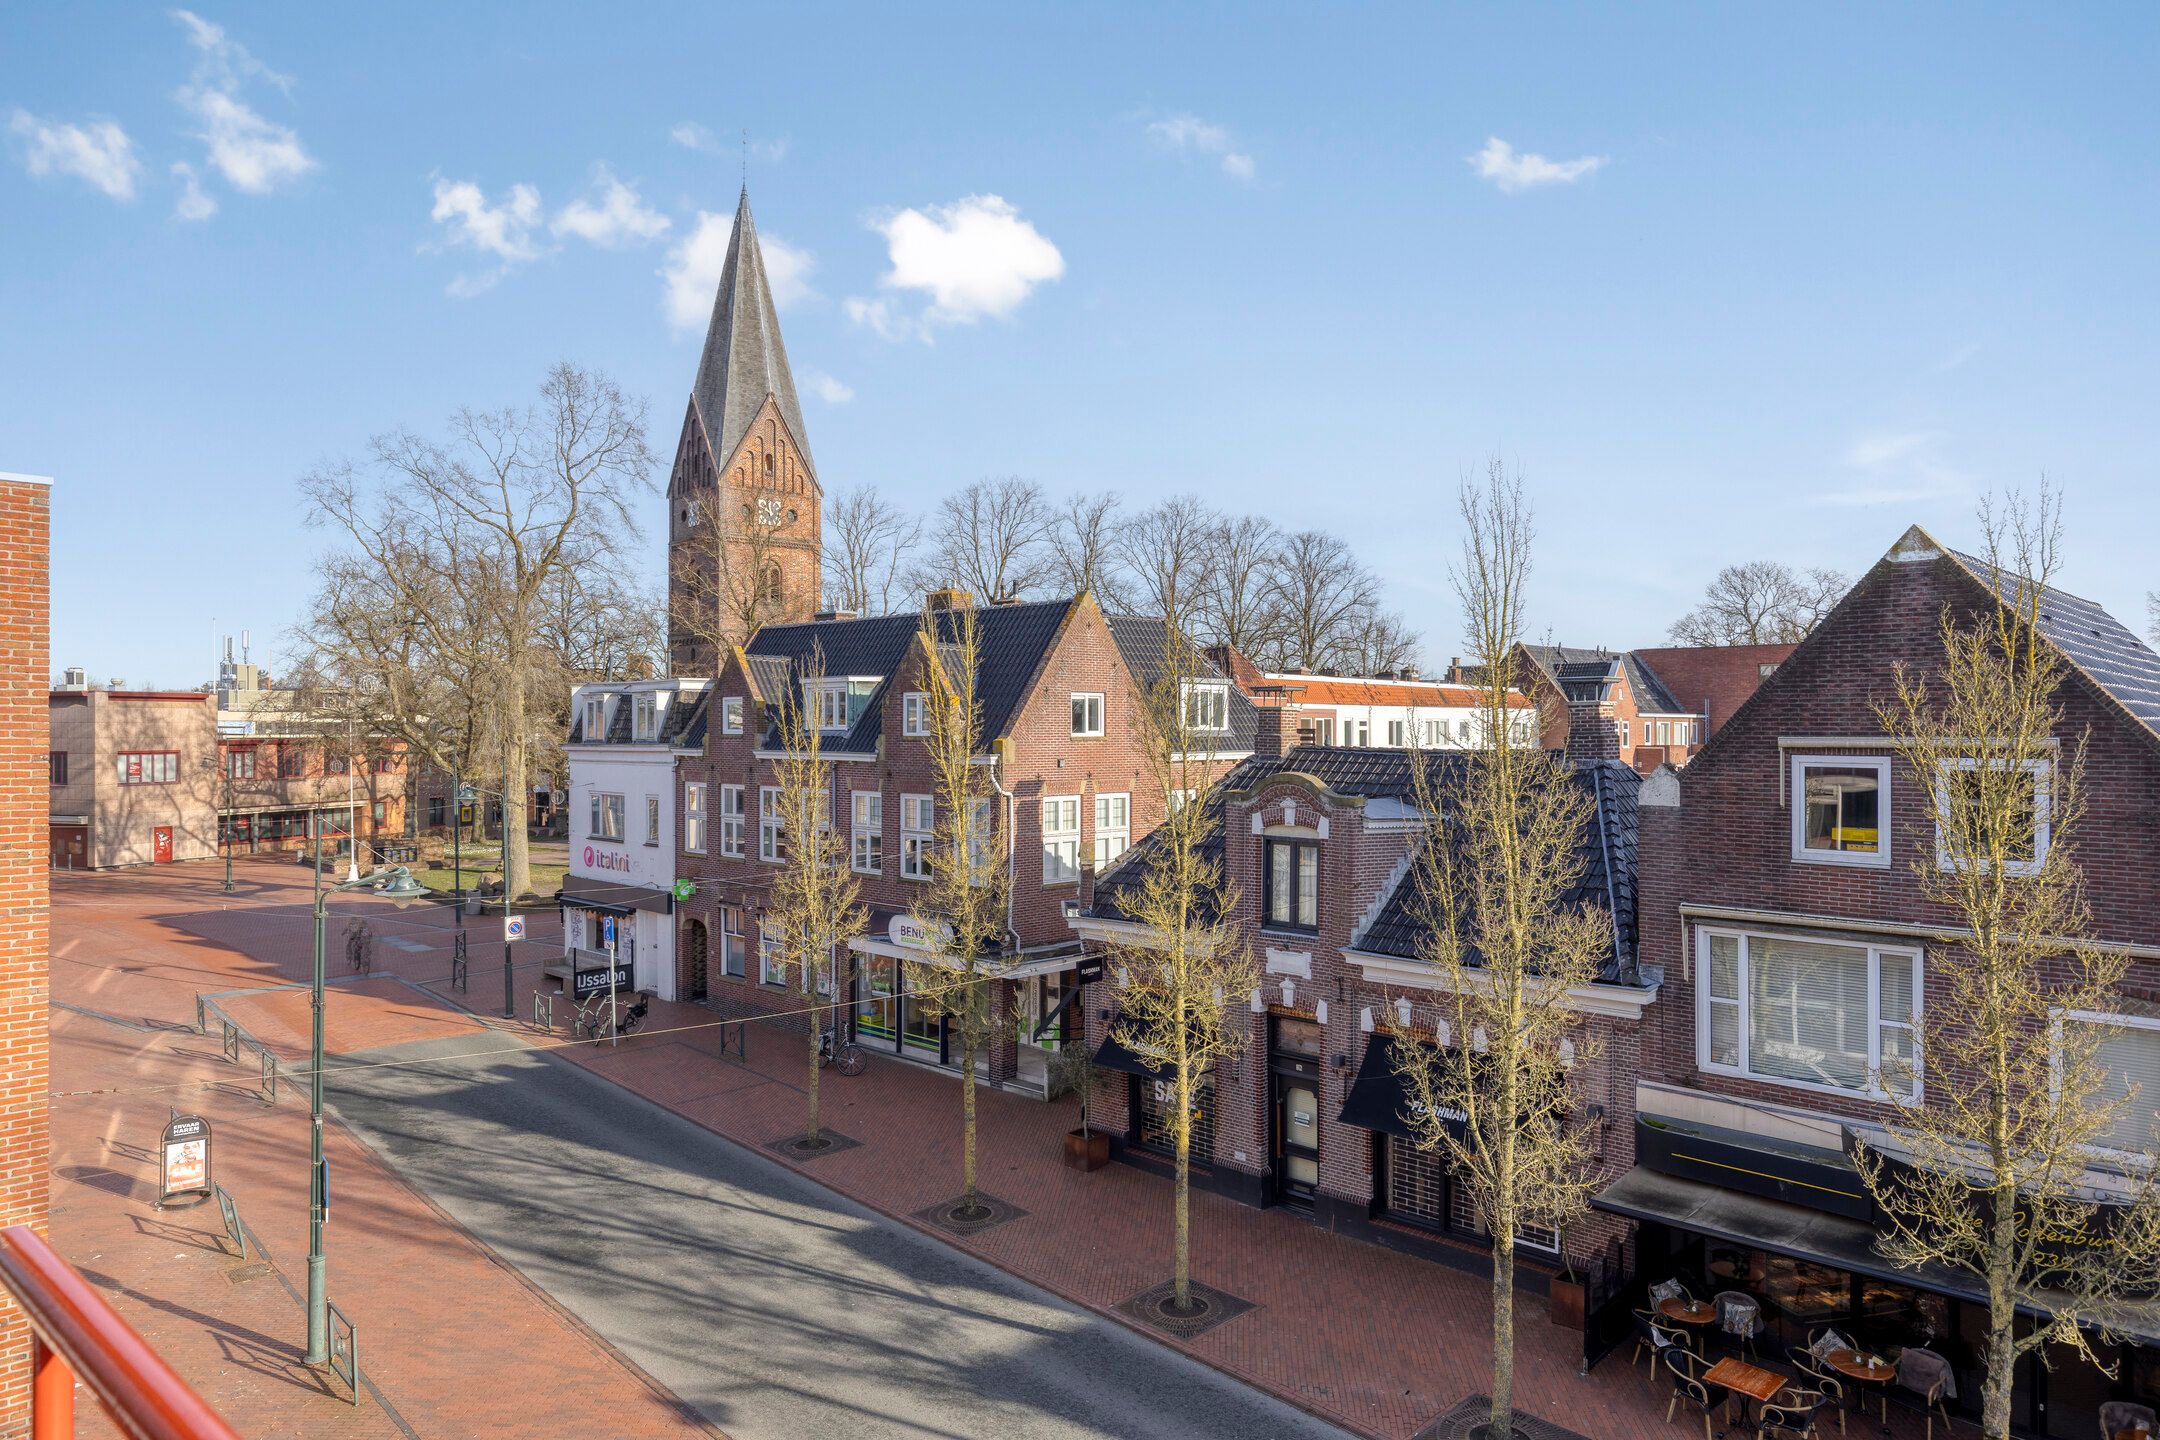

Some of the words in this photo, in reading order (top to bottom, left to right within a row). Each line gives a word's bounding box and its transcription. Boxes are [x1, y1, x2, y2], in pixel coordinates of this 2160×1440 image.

[596, 850, 630, 872] italini
[605, 919, 611, 931] P
[900, 925, 925, 939] BENU
[577, 970, 626, 988] IJssalon
[1154, 1080, 1198, 1105] SAE
[173, 1126, 200, 1135] HAREN
